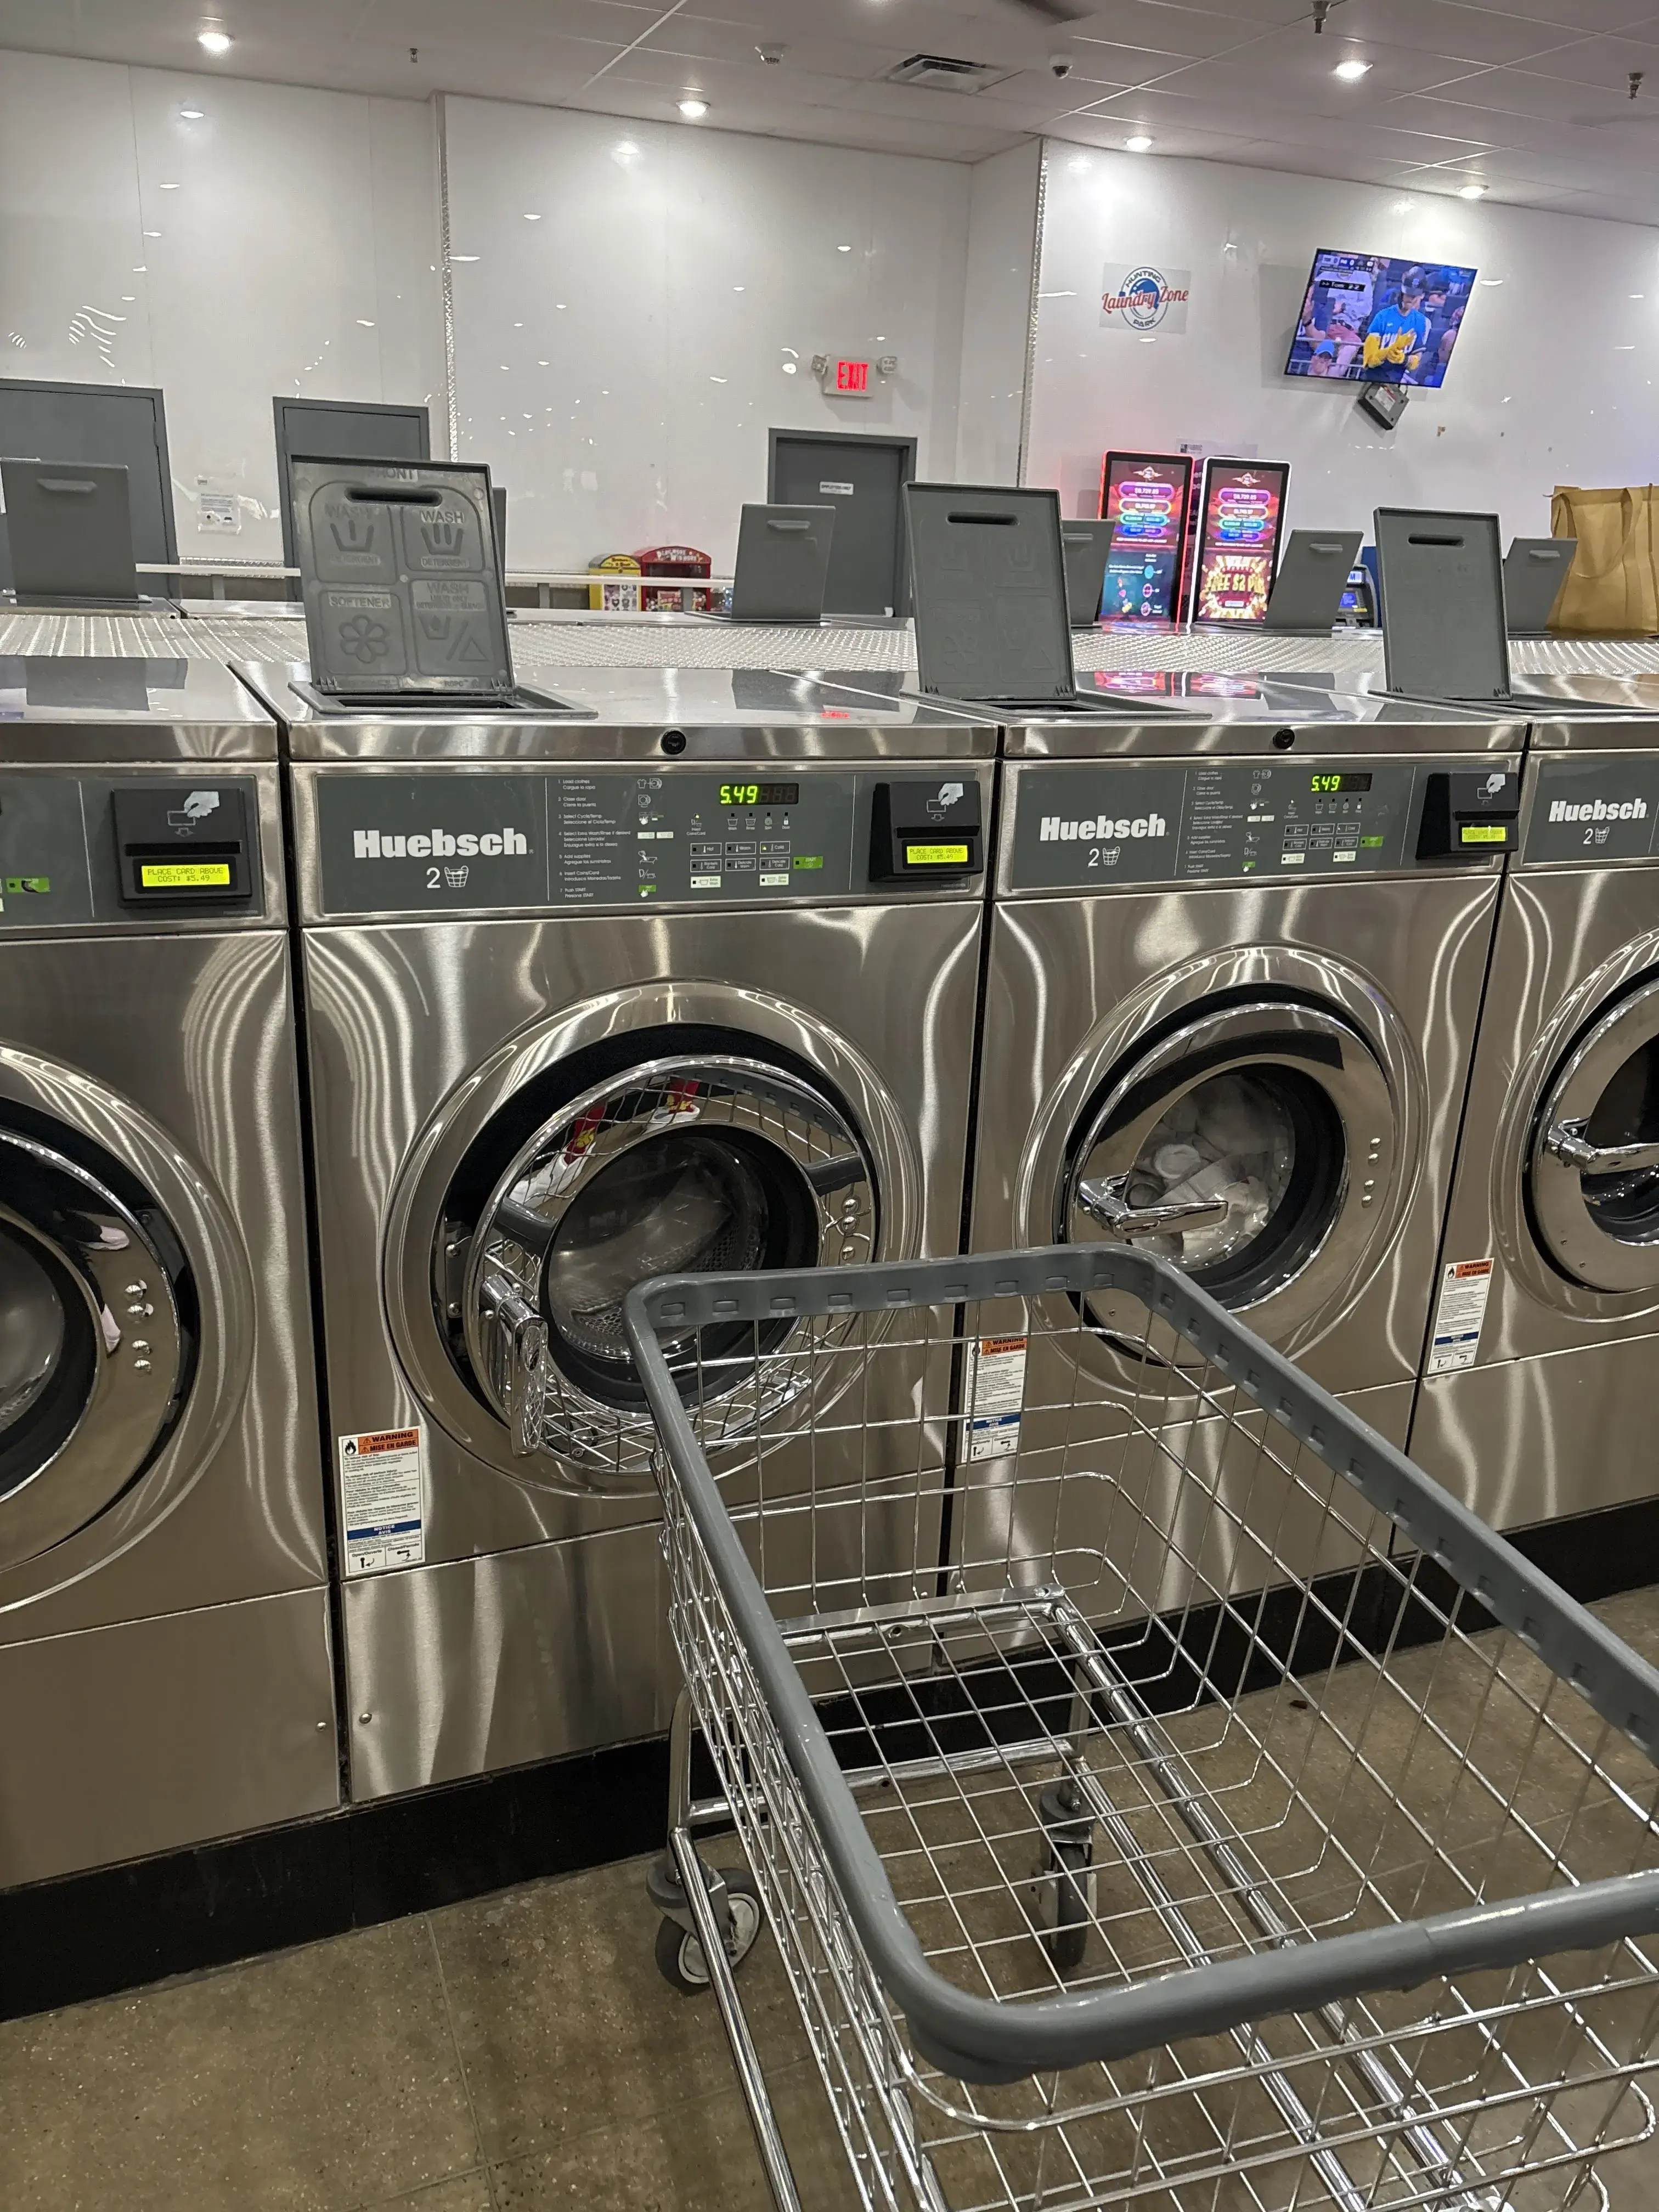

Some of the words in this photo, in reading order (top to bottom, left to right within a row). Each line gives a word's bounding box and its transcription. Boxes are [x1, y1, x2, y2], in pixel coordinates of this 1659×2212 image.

[1126, 270, 1161, 288] HUNTING
[1102, 290, 1157, 314] Laundry
[1159, 285, 1189, 303] Zone
[1133, 317, 1156, 327] PARK
[837, 360, 869, 391] EXIT
[420, 509, 465, 524] WASH
[427, 582, 469, 594] WASH
[330, 596, 391, 607] SOFTENER
[1311, 775, 1341, 791] 5.49
[720, 786, 758, 804] 5.49
[1548, 798, 1647, 822] Huebsch
[1040, 813, 1166, 841] Huebsch
[353, 827, 527, 859] Huebsch
[1583, 828, 1593, 845] 2
[1088, 848, 1099, 867] 2
[426, 867, 441, 889] 2
[1464, 1261, 1489, 1270] WARNING
[371, 1431, 414, 1442] WARNING
[370, 1443, 386, 1452] MISE
[396, 1440, 416, 1448] GARDE
